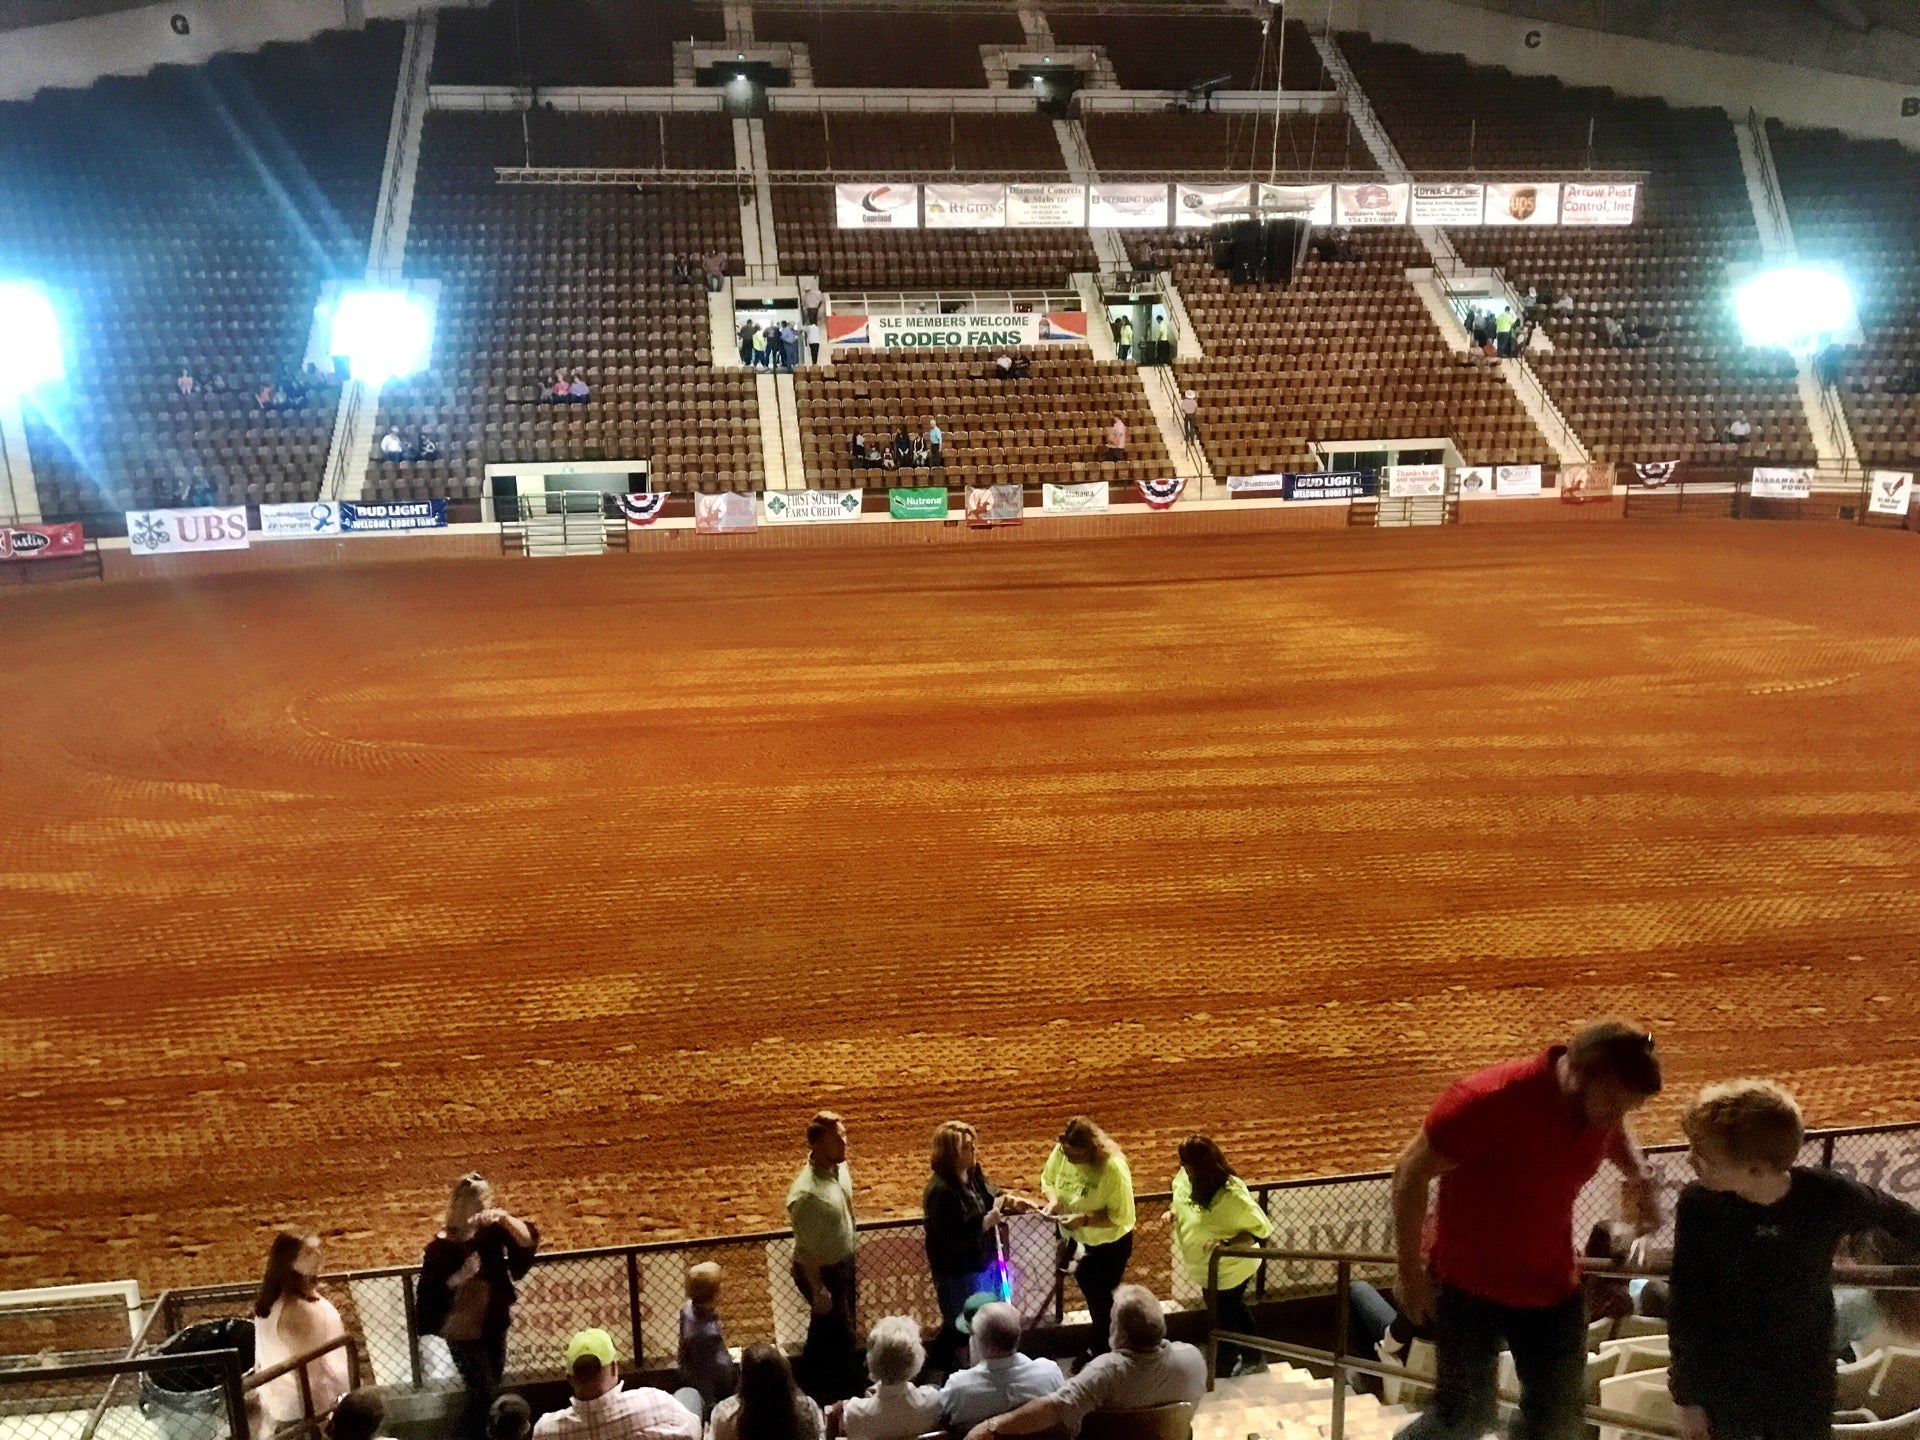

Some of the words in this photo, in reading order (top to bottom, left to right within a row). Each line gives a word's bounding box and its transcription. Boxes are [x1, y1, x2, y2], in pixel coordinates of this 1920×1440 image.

[170, 14, 190, 35] G
[1525, 31, 1541, 48] C
[1901, 98, 1920, 117] B
[1009, 186, 1045, 195] Diamond
[1047, 186, 1082, 195] Concrete
[1568, 186, 1604, 197] Arrow
[1608, 186, 1633, 197] Pest
[1022, 195, 1030, 203] &
[1033, 195, 1055, 203] Slabs
[1102, 195, 1141, 203] STERLING
[1142, 195, 1166, 203] BANK
[949, 202, 1004, 213] REGIONS
[1511, 196, 1535, 217] ups
[1563, 201, 1610, 213] Control,
[1613, 201, 1633, 212] Inc.
[862, 214, 892, 223] Copeland
[879, 317, 902, 328] SLE
[905, 316, 966, 328] MEMBERS
[969, 316, 1029, 327] WELCOME
[884, 331, 962, 347] RODEO
[967, 330, 1022, 346] FANS
[1396, 469, 1420, 477] Thanks
[1430, 468, 1440, 476] all
[1244, 478, 1281, 487] Trustmark
[1297, 477, 1323, 488] BUD
[1409, 475, 1440, 484] sponsors
[1293, 489, 1324, 498] WELCOME
[1324, 488, 1346, 497] RODEO
[787, 493, 811, 507] FIRST
[811, 492, 840, 506] SOUTH
[906, 495, 941, 506] Nutrena
[356, 504, 388, 516] BUD
[388, 503, 429, 516] LIGHT
[785, 506, 809, 518] FARM
[810, 506, 842, 517] CREDIT
[175, 513, 247, 543] UBS
[352, 519, 390, 529] WELCOME
[390, 518, 417, 528] RODEO
[417, 517, 437, 527] FANS
